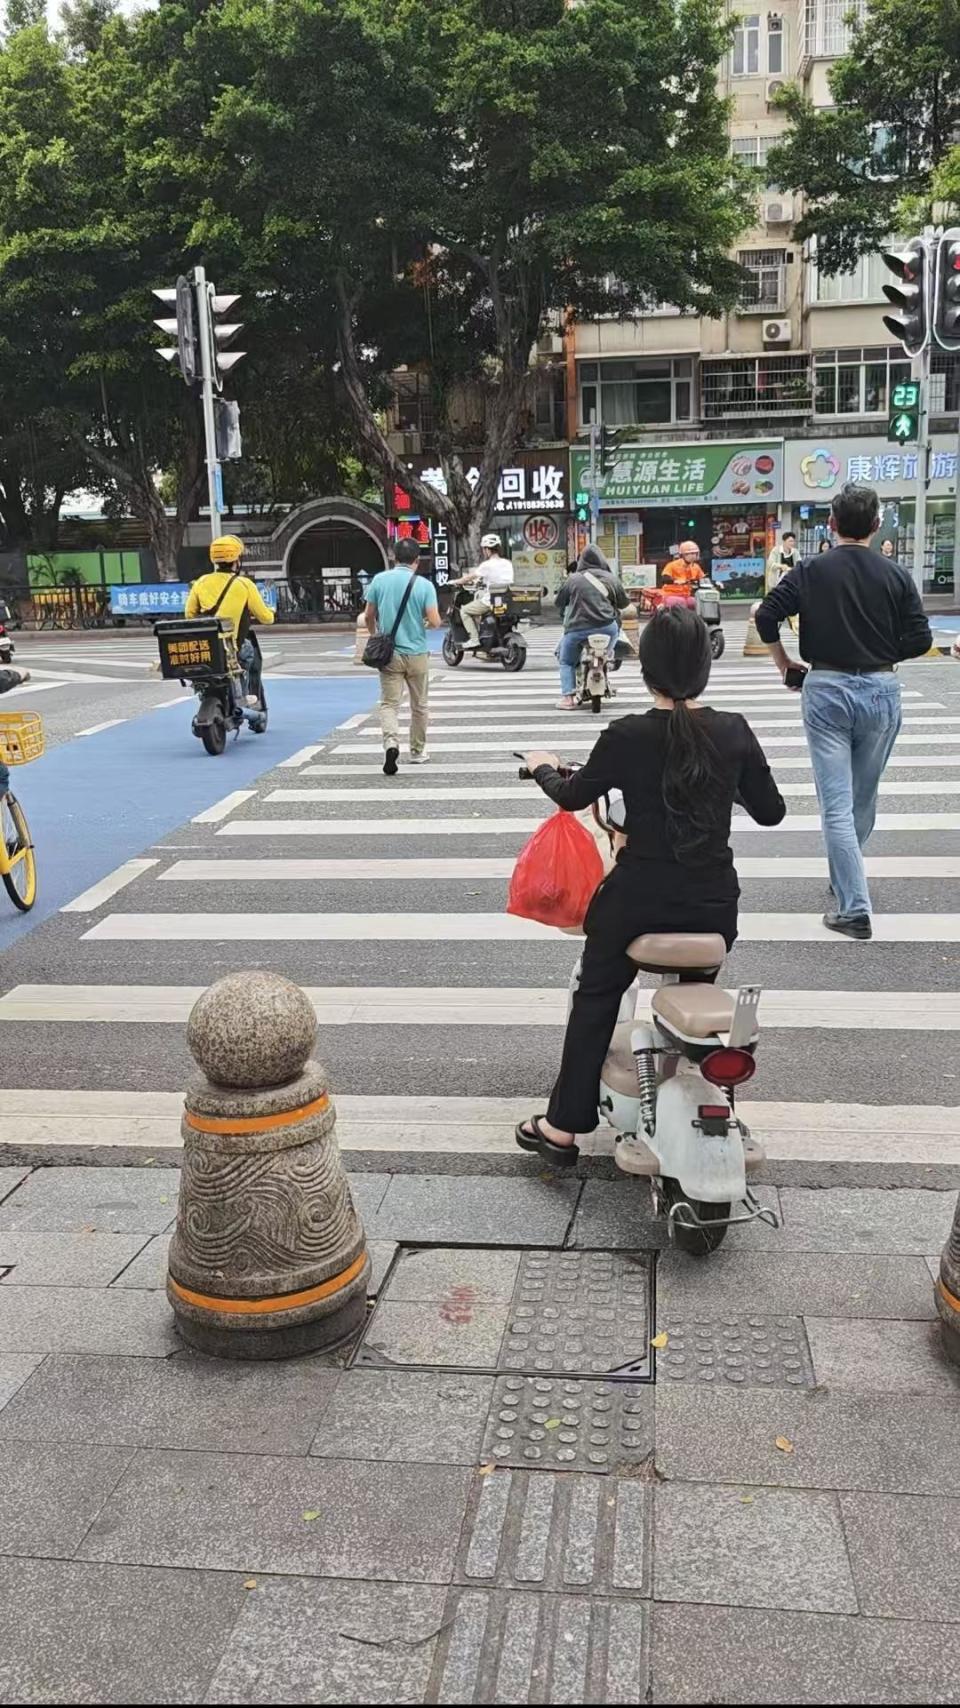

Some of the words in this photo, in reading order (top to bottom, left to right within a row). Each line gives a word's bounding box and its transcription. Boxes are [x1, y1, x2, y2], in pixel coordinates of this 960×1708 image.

[893, 386, 917, 406] 23
[606, 483, 671, 496] HUIYUAN
[674, 482, 704, 494] LIFE
[434, 522, 449, 586] 上门回收
[168, 640, 210, 653] 美团配送
[170, 651, 211, 665] 准时好用
